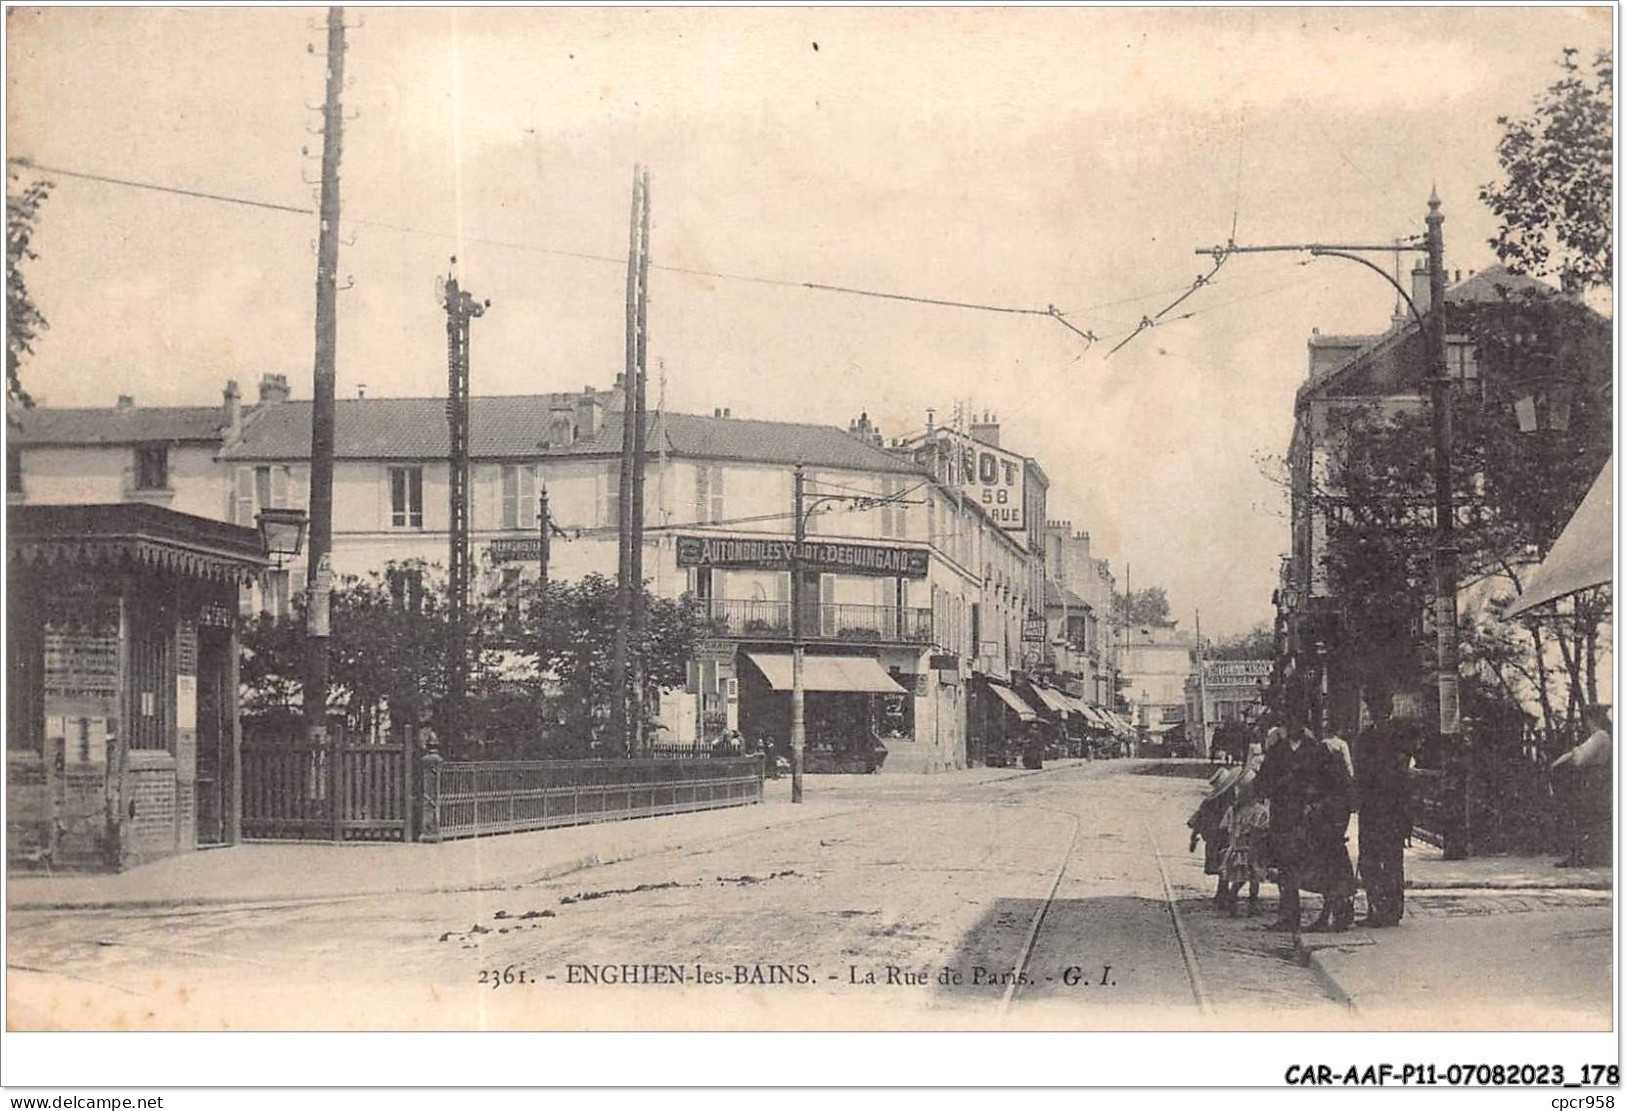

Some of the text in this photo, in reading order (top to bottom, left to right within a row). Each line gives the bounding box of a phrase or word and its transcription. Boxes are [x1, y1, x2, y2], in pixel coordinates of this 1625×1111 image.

[982, 488, 1008, 504] 58
[991, 508, 1020, 522] RUE
[699, 539, 781, 564] AUTOMOBILES
[478, 964, 536, 989] 2361.
[565, 963, 817, 985] ENGHIEN-les-BAINS.
[849, 965, 876, 985] La
[886, 966, 929, 986] Rue
[938, 965, 963, 986] de
[972, 966, 1035, 986] Paris.
[1063, 966, 1089, 986] G.
[1099, 966, 1117, 986] I.
